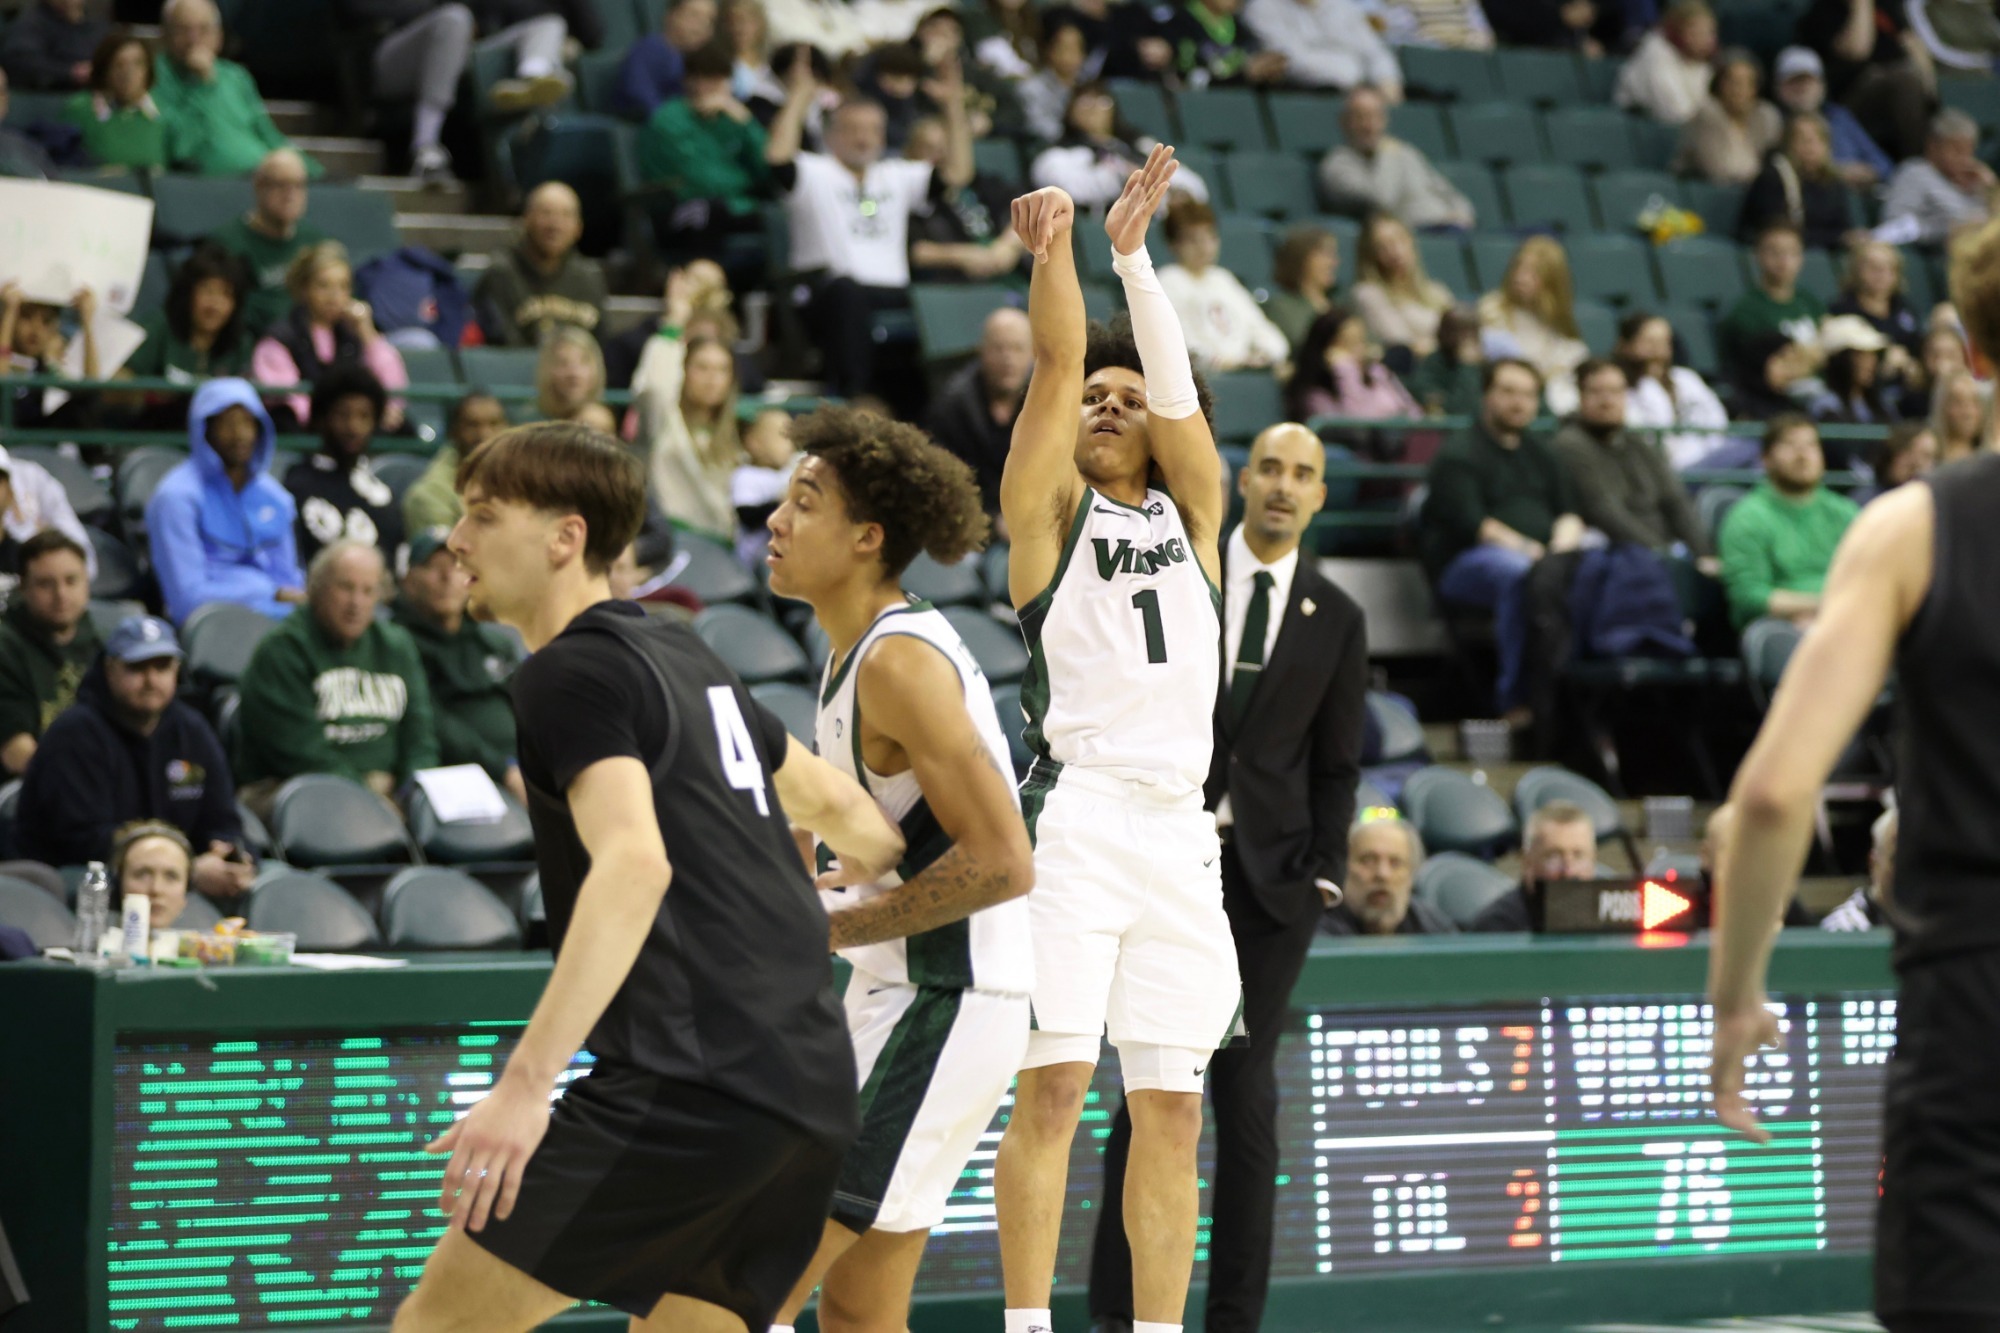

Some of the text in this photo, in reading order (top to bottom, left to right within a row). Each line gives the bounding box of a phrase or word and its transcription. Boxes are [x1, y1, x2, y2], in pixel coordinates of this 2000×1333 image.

[1091, 537, 1188, 582] VIKING
[1131, 589, 1167, 664] 1
[706, 685, 770, 817] 4
[1326, 1026, 1534, 1108] FOULS 7
[1362, 1168, 1542, 1253] TOL 2
[1641, 1140, 1732, 1252] 76
